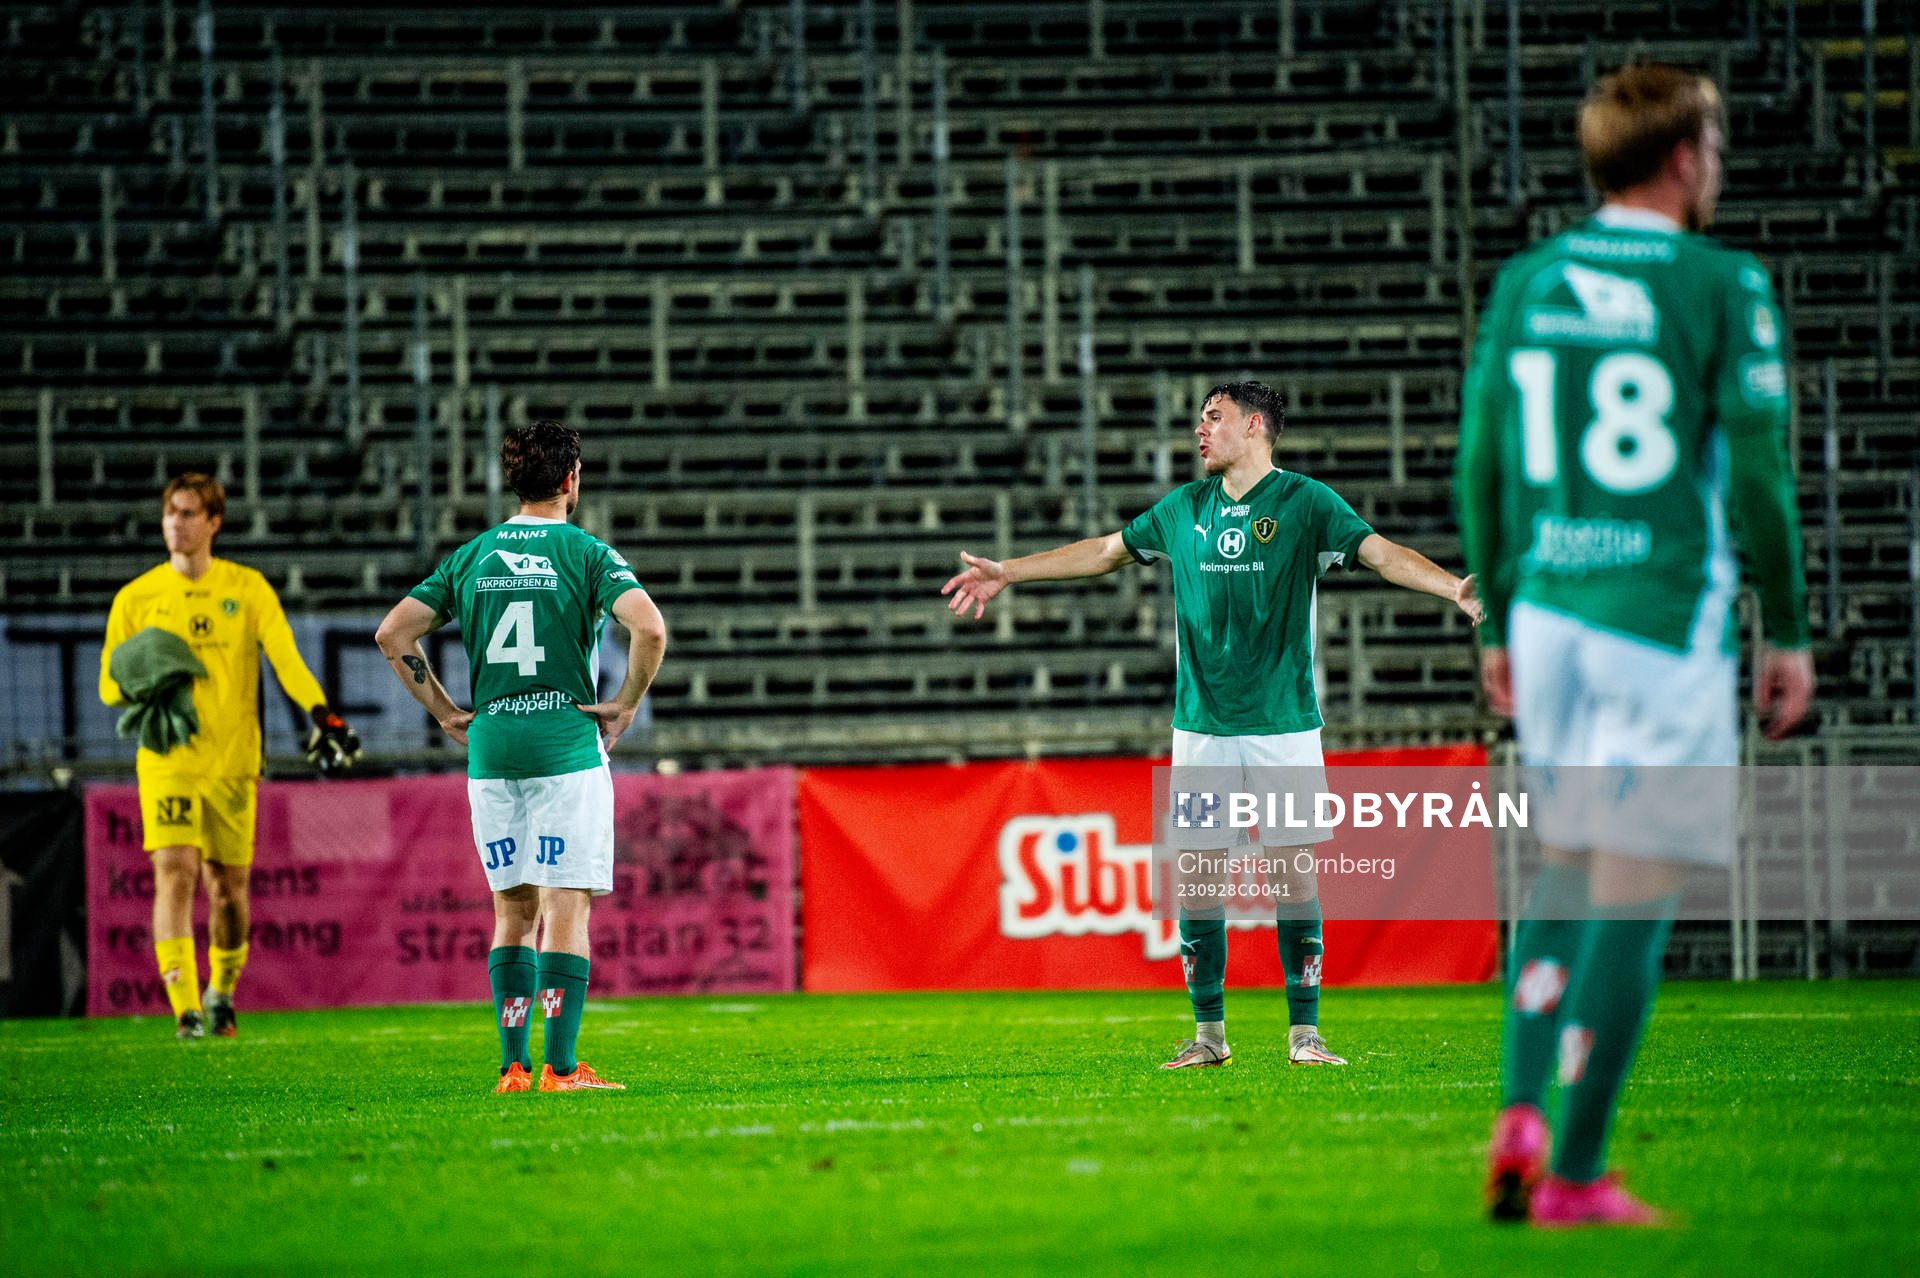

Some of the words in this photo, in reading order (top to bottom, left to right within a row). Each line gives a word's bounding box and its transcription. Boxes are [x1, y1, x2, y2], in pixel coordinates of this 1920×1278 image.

[1510, 349, 1678, 493] 18
[496, 529, 548, 540] MANNS
[1200, 562, 1250, 573] Holmgrens
[1252, 562, 1264, 571] Bil
[476, 578, 541, 590] TAKPROFFSEN
[543, 578, 558, 588] AB
[486, 600, 545, 677] 4
[486, 836, 517, 870] JP
[536, 835, 566, 866] JP
